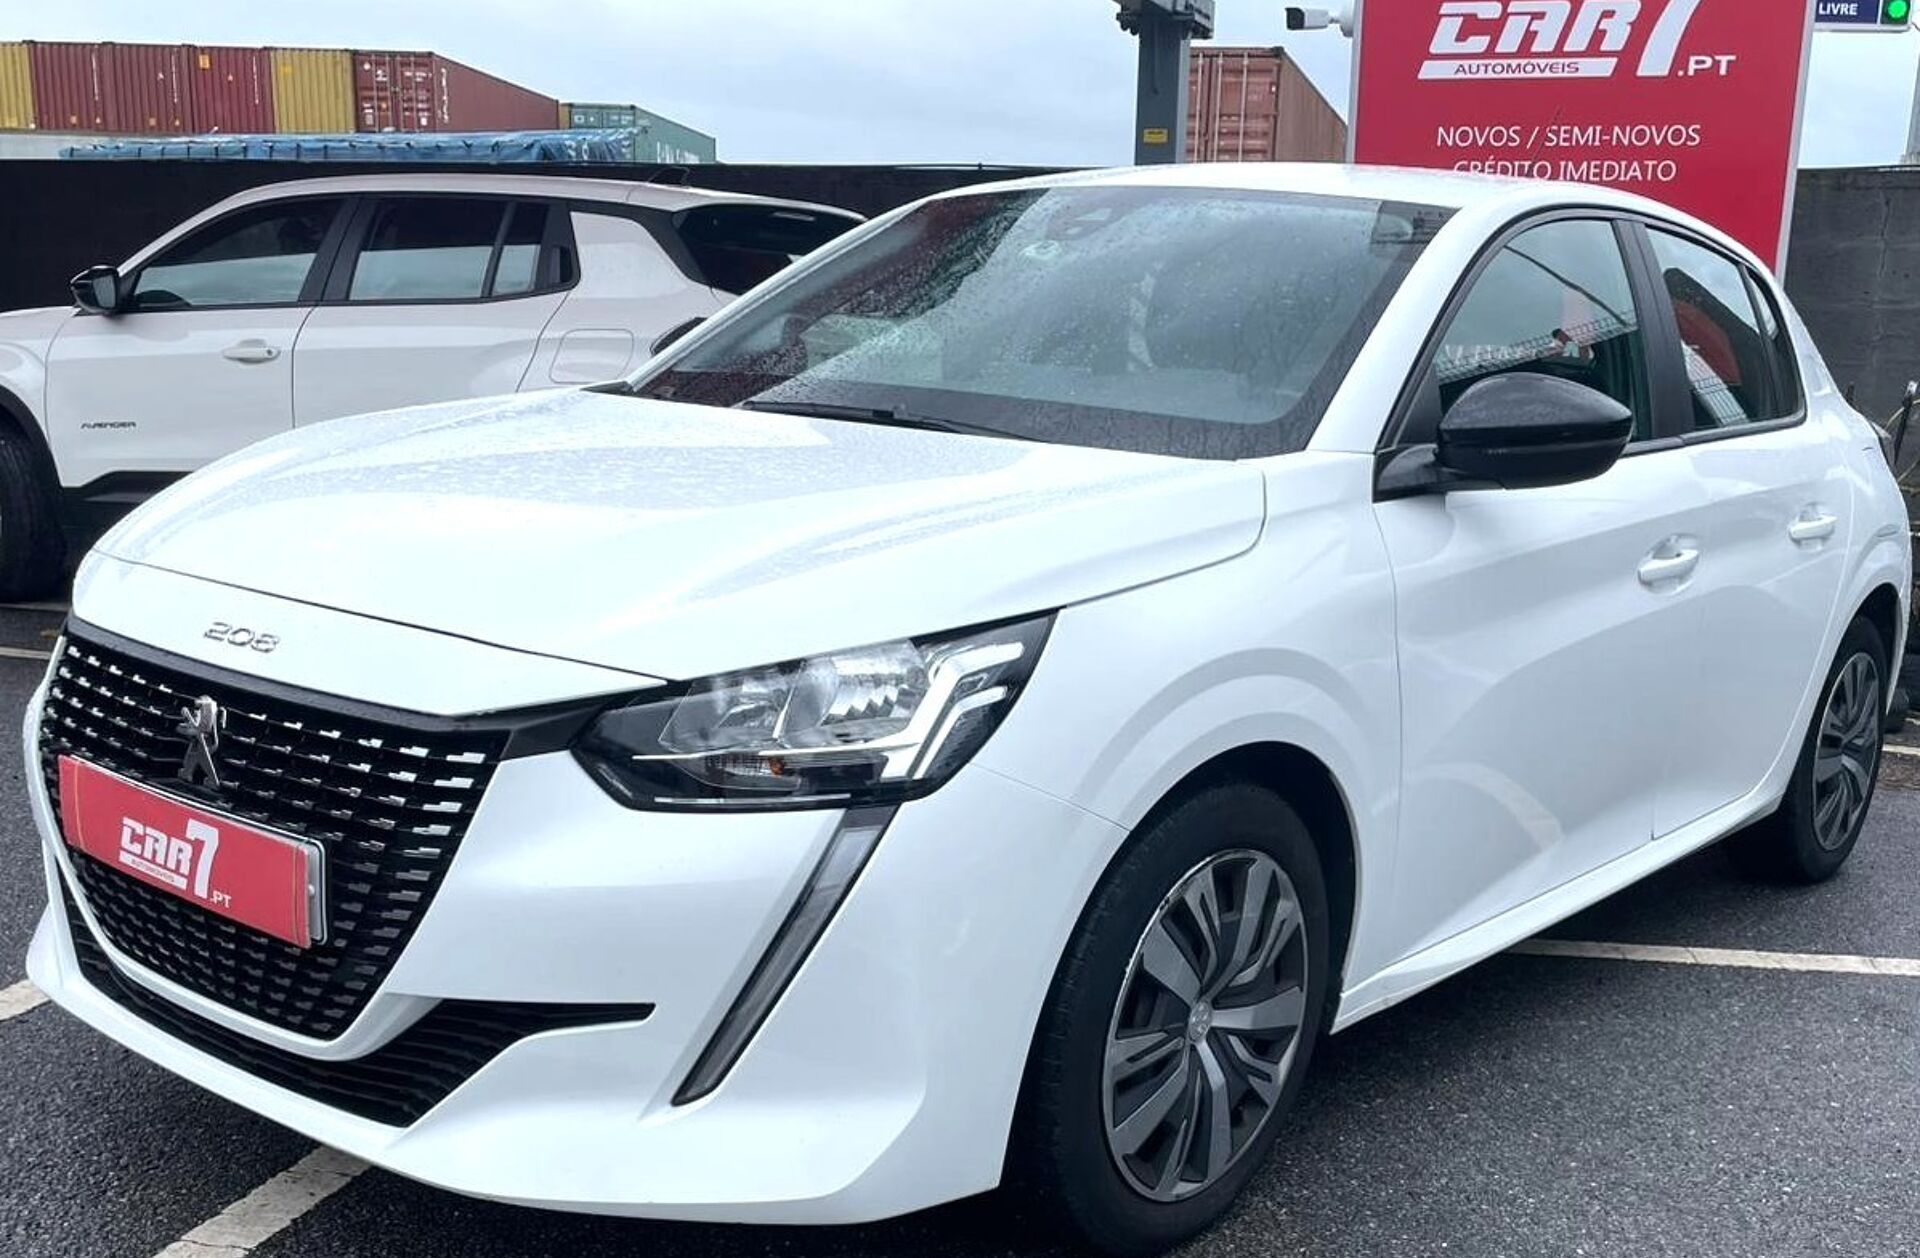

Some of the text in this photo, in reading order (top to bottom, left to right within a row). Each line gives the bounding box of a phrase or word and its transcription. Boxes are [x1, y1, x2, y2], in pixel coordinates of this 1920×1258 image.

[1818, 2, 1858, 16] LIVRE
[1453, 61, 1580, 76] AUTOMÓVEIS
[1436, 126, 1521, 147] NOVOS
[1546, 124, 1702, 147] SEMI-NOVOS
[1559, 159, 1677, 182] IMEDIATO
[203, 621, 281, 654] 208
